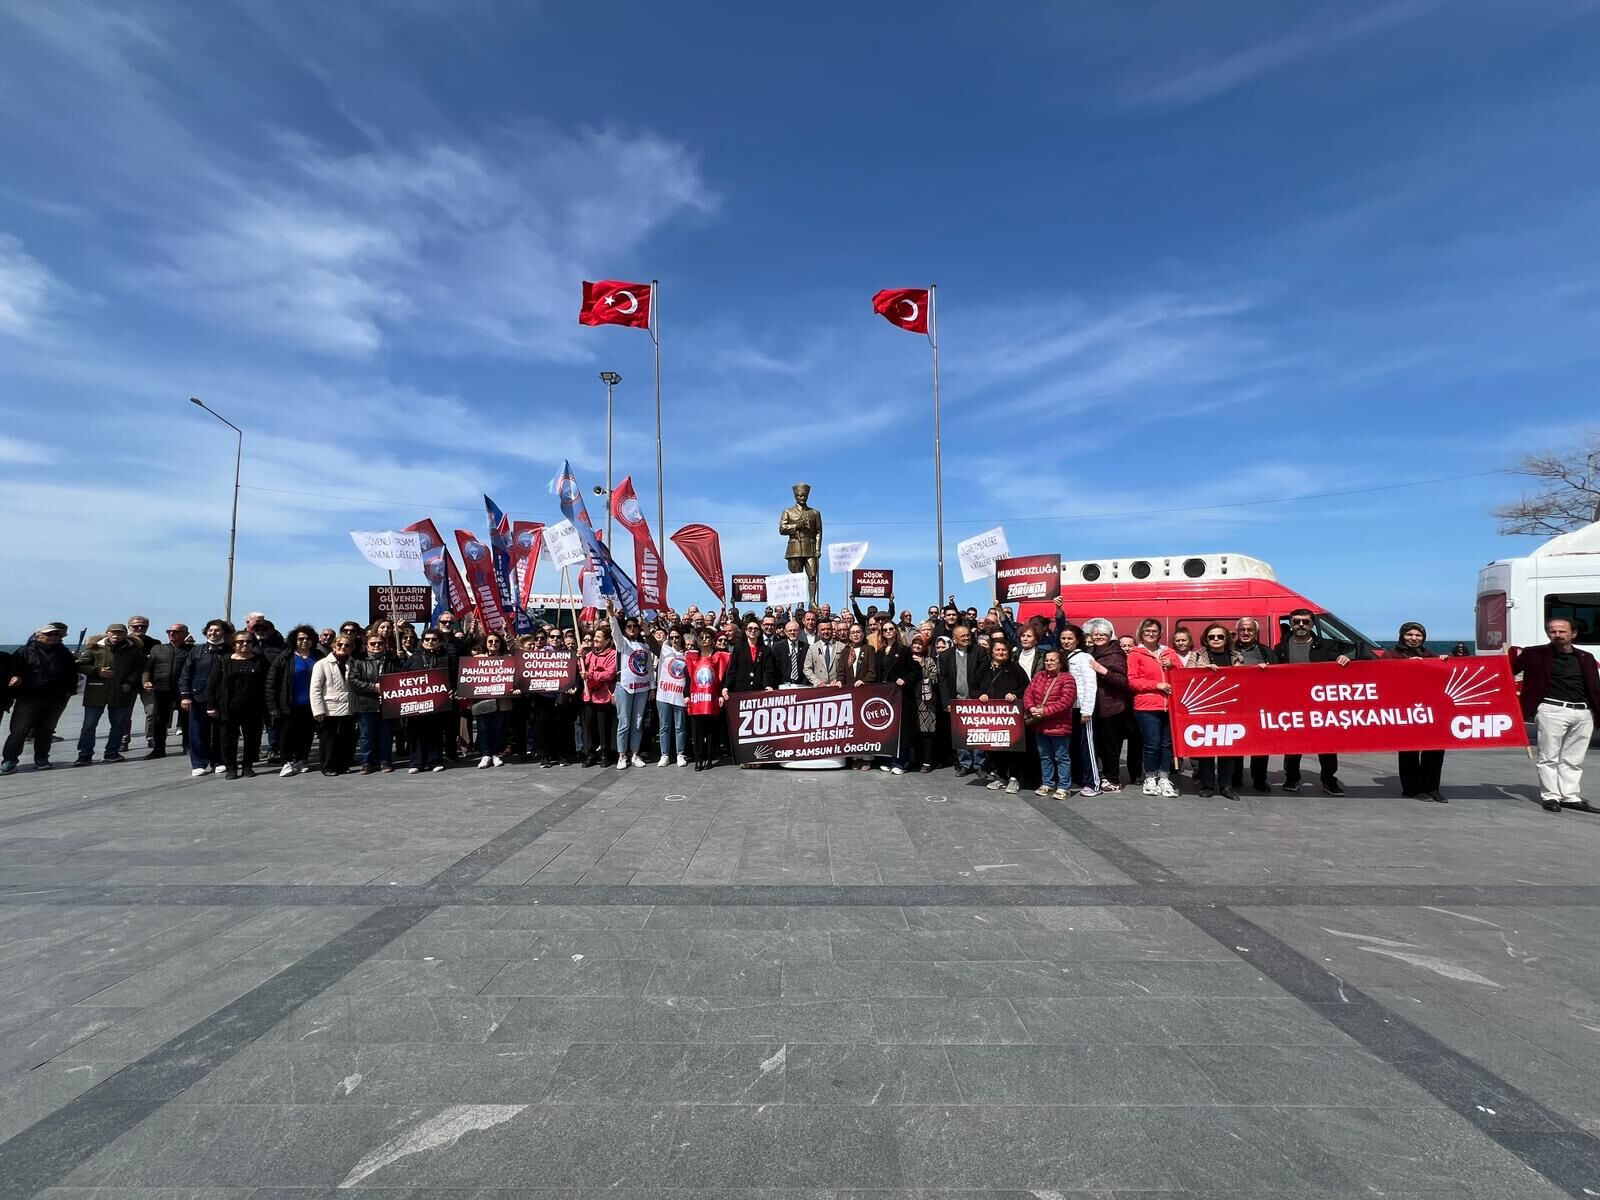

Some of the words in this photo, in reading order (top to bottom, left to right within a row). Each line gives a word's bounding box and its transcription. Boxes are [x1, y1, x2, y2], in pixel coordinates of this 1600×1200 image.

[863, 571, 884, 579] DÜŞÜK
[997, 564, 1058, 579] HUKUKSUZLUĞA
[739, 583, 764, 591] ŞİDDETE
[1007, 583, 1047, 597] ZORUNDA
[380, 594, 424, 602] GÜVENSİZ
[522, 652, 571, 660] OKULLARIN
[525, 660, 568, 669] GÜVENSİZ
[399, 674, 429, 687] KEYFİ
[491, 674, 514, 682] EĞME
[523, 670, 569, 678] OLMASINA
[383, 684, 448, 699] KARARLARA
[1310, 683, 1378, 702] GERZE
[400, 701, 434, 713] ZORUNDA
[739, 695, 797, 710] KATLANMAK
[865, 708, 879, 720] ÜYE
[881, 707, 889, 717] OL
[956, 705, 1020, 714] PAHALILIKLA
[739, 700, 854, 737] ZORUNDA
[960, 716, 1016, 727] YAŞAMAYA
[1260, 709, 1304, 731] İLÇE
[1310, 703, 1434, 729] BAŞKANLIĞI
[1451, 714, 1513, 739] CHP
[803, 727, 854, 743] DEĞİLSİNİZ
[966, 732, 1010, 743] ZORUNDA
[1183, 724, 1246, 747] CHP
[775, 749, 794, 758] CHP
[795, 746, 833, 757] SAMSUN
[834, 744, 842, 754] İL
[843, 742, 881, 753] ÖRGÜTÜ
